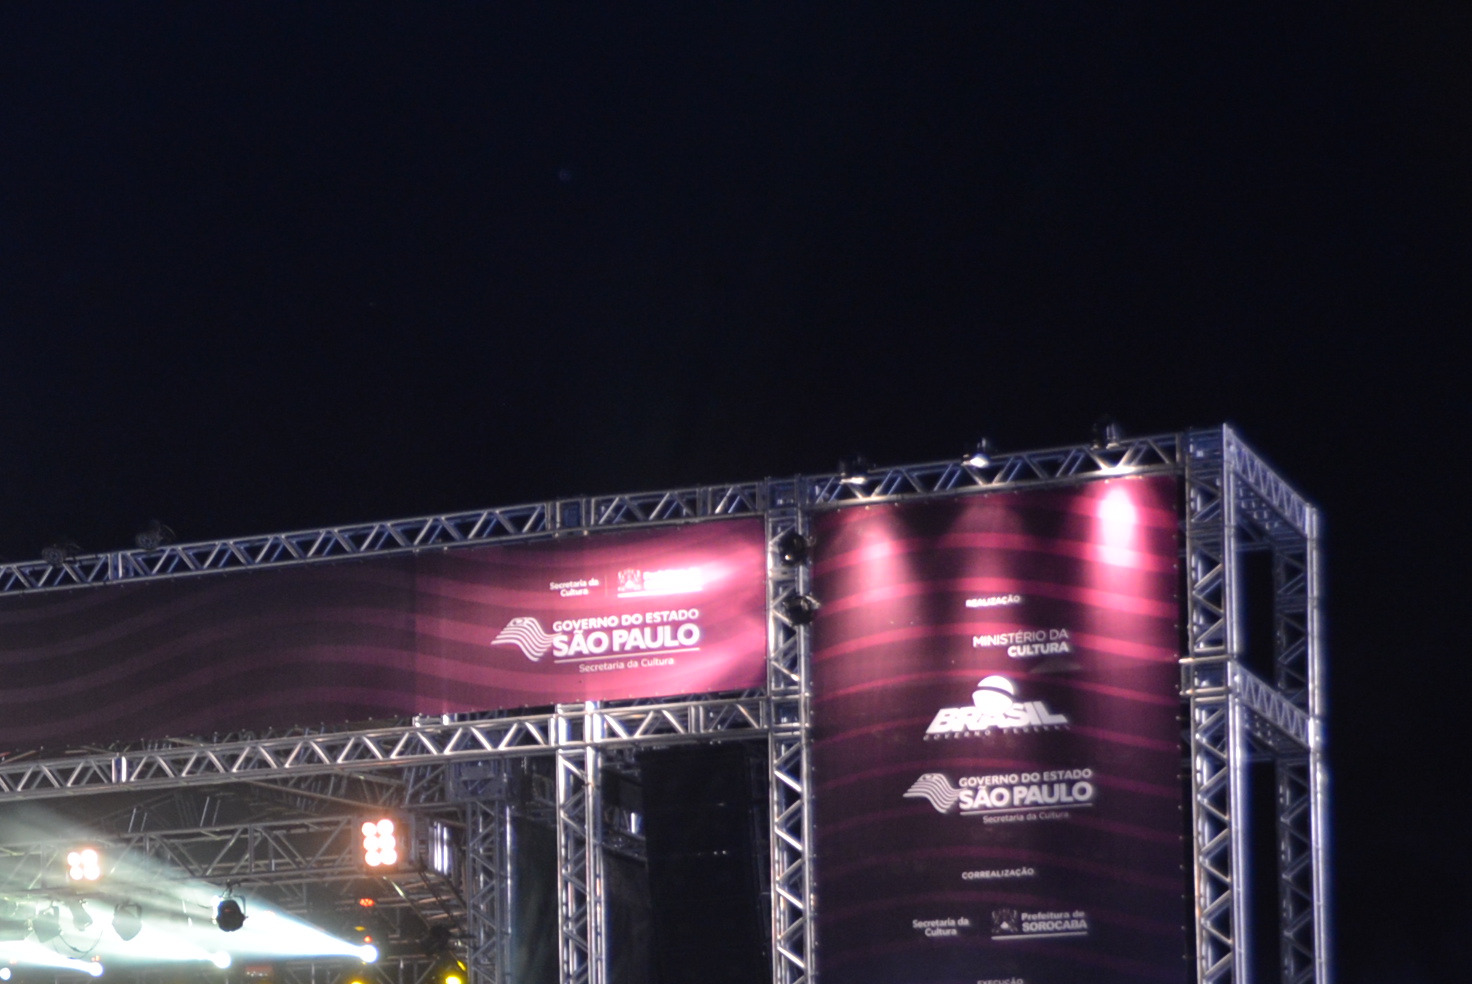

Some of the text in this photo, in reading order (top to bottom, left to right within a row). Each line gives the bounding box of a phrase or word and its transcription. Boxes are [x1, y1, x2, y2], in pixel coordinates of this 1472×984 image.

[550, 577, 599, 590] Secretaria da
[560, 586, 589, 598] Cultura
[553, 608, 700, 632] GOVERNO DO ESTADO
[552, 623, 700, 658] SÃO PAULO
[973, 628, 1069, 648] MINISTÉRIO DA
[1007, 641, 1070, 658] CULTURA
[578, 657, 675, 674] Secretaria da Cultura
[925, 700, 1069, 734] BRASIL
[959, 768, 1093, 787] GOVERNO DO ESTADO
[959, 781, 1093, 810] SÃO PAULO
[982, 810, 1069, 824] Secretaria da Cultura
[962, 866, 1034, 880] CORREALIZAÇÃO
[912, 916, 969, 928] Secretaria da
[1021, 910, 1085, 921] Prefeitura de
[924, 926, 957, 937] Cultura
[1022, 920, 1088, 932] SOROCABA
